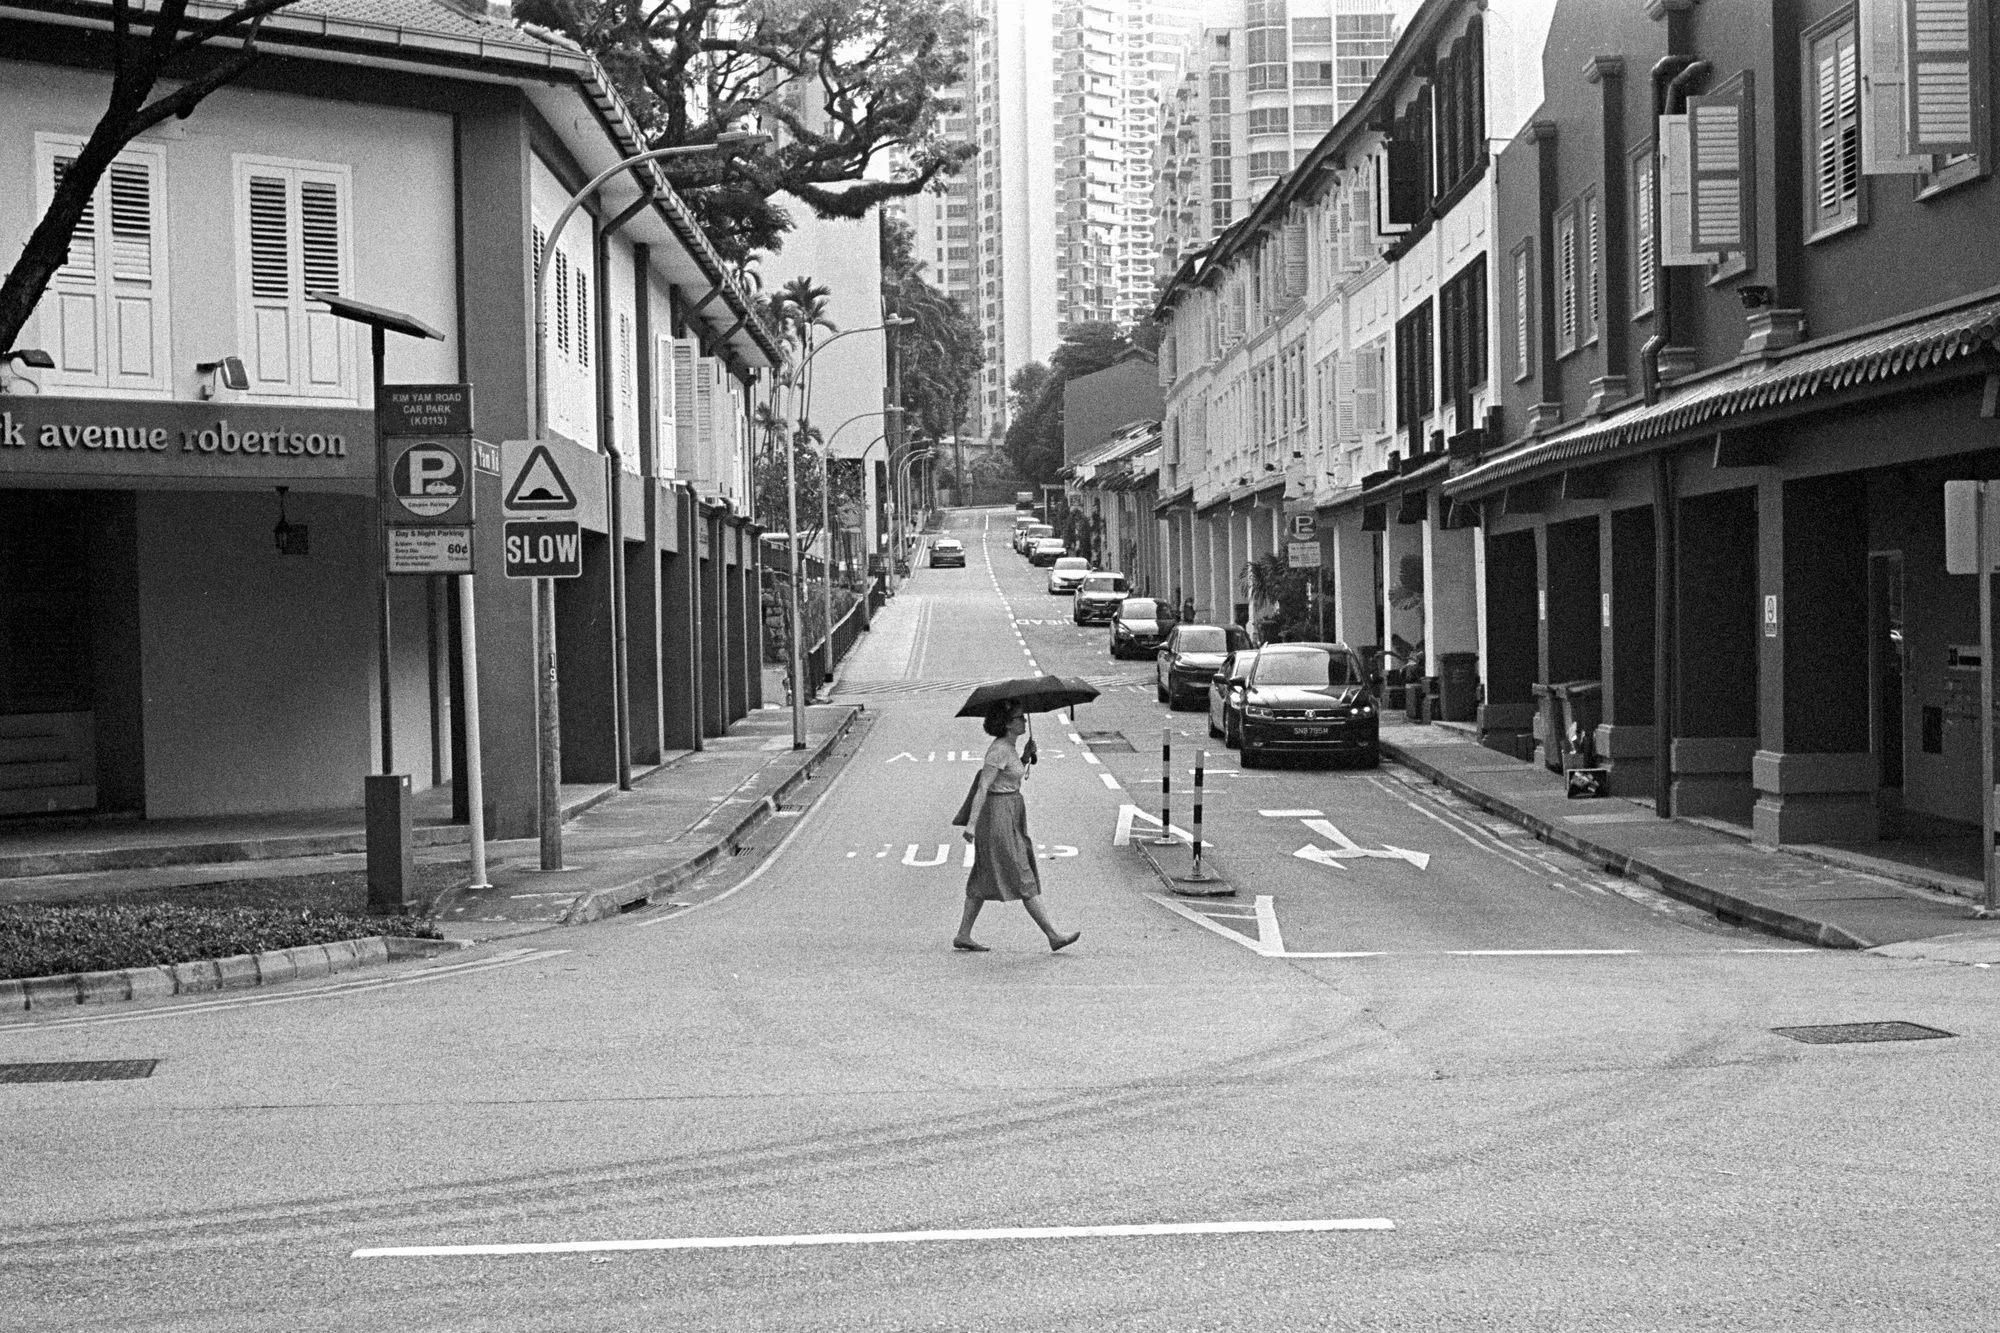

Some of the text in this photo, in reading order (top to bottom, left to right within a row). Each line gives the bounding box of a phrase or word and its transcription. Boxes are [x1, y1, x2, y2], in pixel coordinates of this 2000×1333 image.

[392, 393, 462, 402] KIM YAM ROAD
[403, 405, 451, 414] CAR PARK
[39, 422, 169, 450] avenue
[180, 419, 346, 456] robertson
[409, 450, 457, 495] P
[395, 530, 409, 538] Day
[417, 530, 436, 538] Night
[437, 530, 464, 538] Parking
[447, 543, 468, 555] 60¢
[507, 534, 578, 564] SLOW
